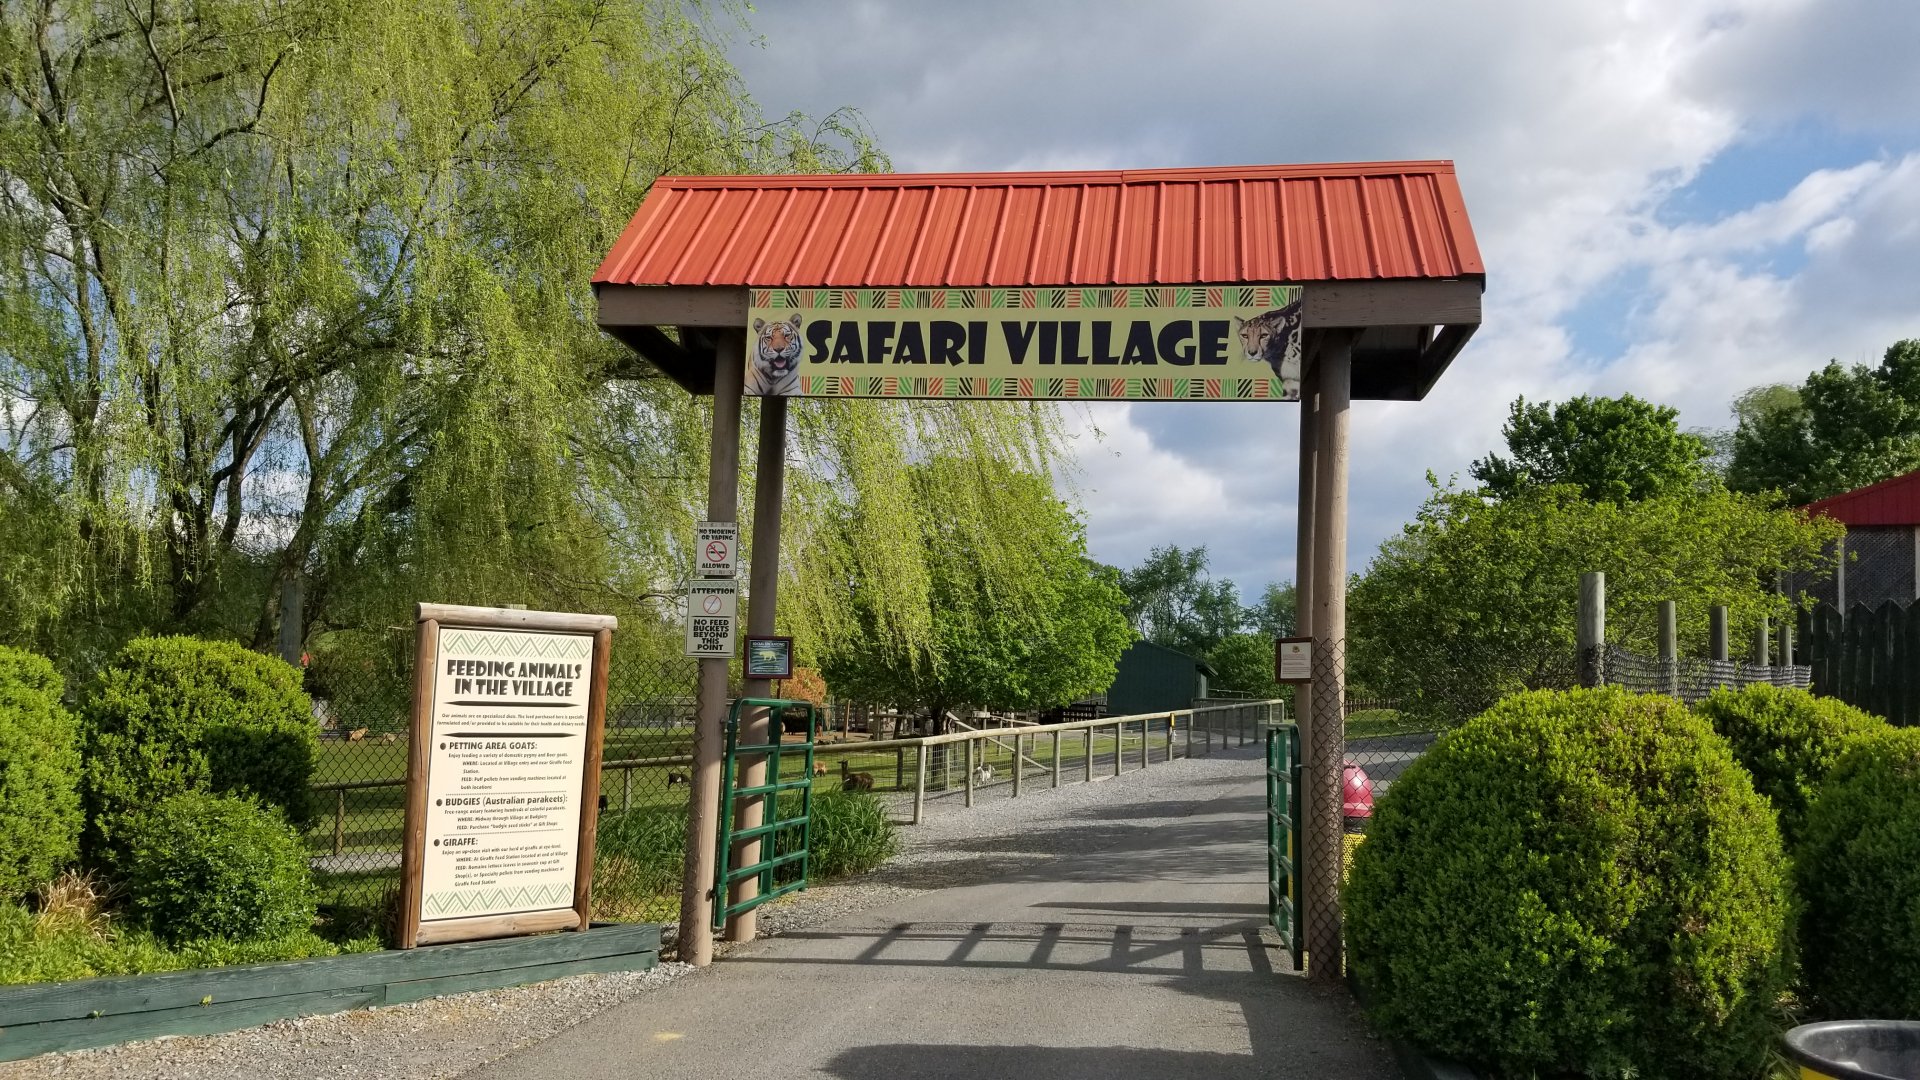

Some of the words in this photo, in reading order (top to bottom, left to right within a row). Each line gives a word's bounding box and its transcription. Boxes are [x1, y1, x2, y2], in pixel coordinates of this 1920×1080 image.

[806, 320, 988, 366] SAFARI
[1002, 320, 1231, 366] VILLAGE
[447, 659, 515, 678] FEEDING
[518, 662, 582, 680] ANIMALS
[454, 678, 472, 695] IN
[476, 679, 508, 696] THE
[512, 680, 573, 697] VILLAGE
[449, 742, 483, 750] PETTING
[485, 742, 507, 750] AREA
[509, 742, 538, 750] GOATS:
[445, 798, 480, 806] BUDGIES
[483, 796, 525, 807] (Australian
[527, 794, 568, 805] parakeets):
[443, 837, 479, 847] GIRAFFE:
